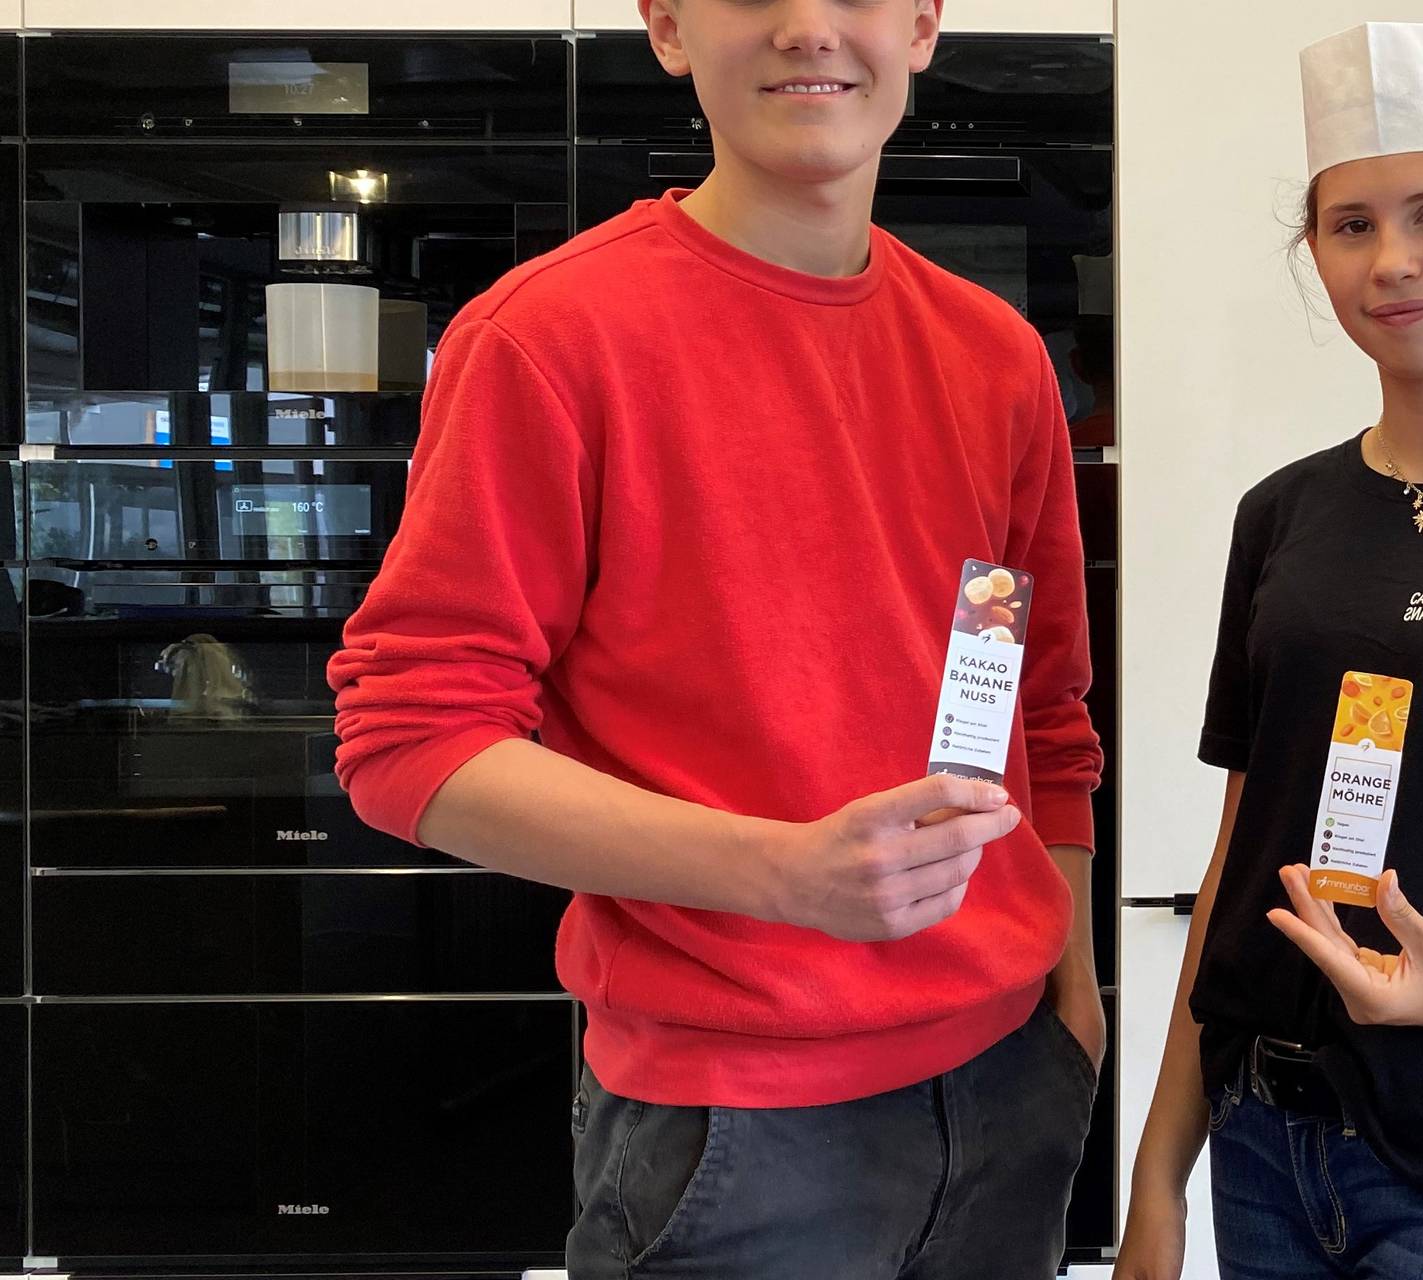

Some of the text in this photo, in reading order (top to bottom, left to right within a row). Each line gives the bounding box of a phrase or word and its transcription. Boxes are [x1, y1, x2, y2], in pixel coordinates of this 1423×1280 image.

[274, 409, 326, 419] Miele
[292, 502, 310, 513] 160
[958, 655, 1008, 674] KAKAO
[949, 670, 1014, 692] BANANE
[960, 688, 997, 705] NUSS
[1331, 771, 1392, 790] ORANGE
[1332, 788, 1385, 806] MÖHRE
[276, 830, 329, 841] Miele
[277, 1204, 330, 1215] Miele
